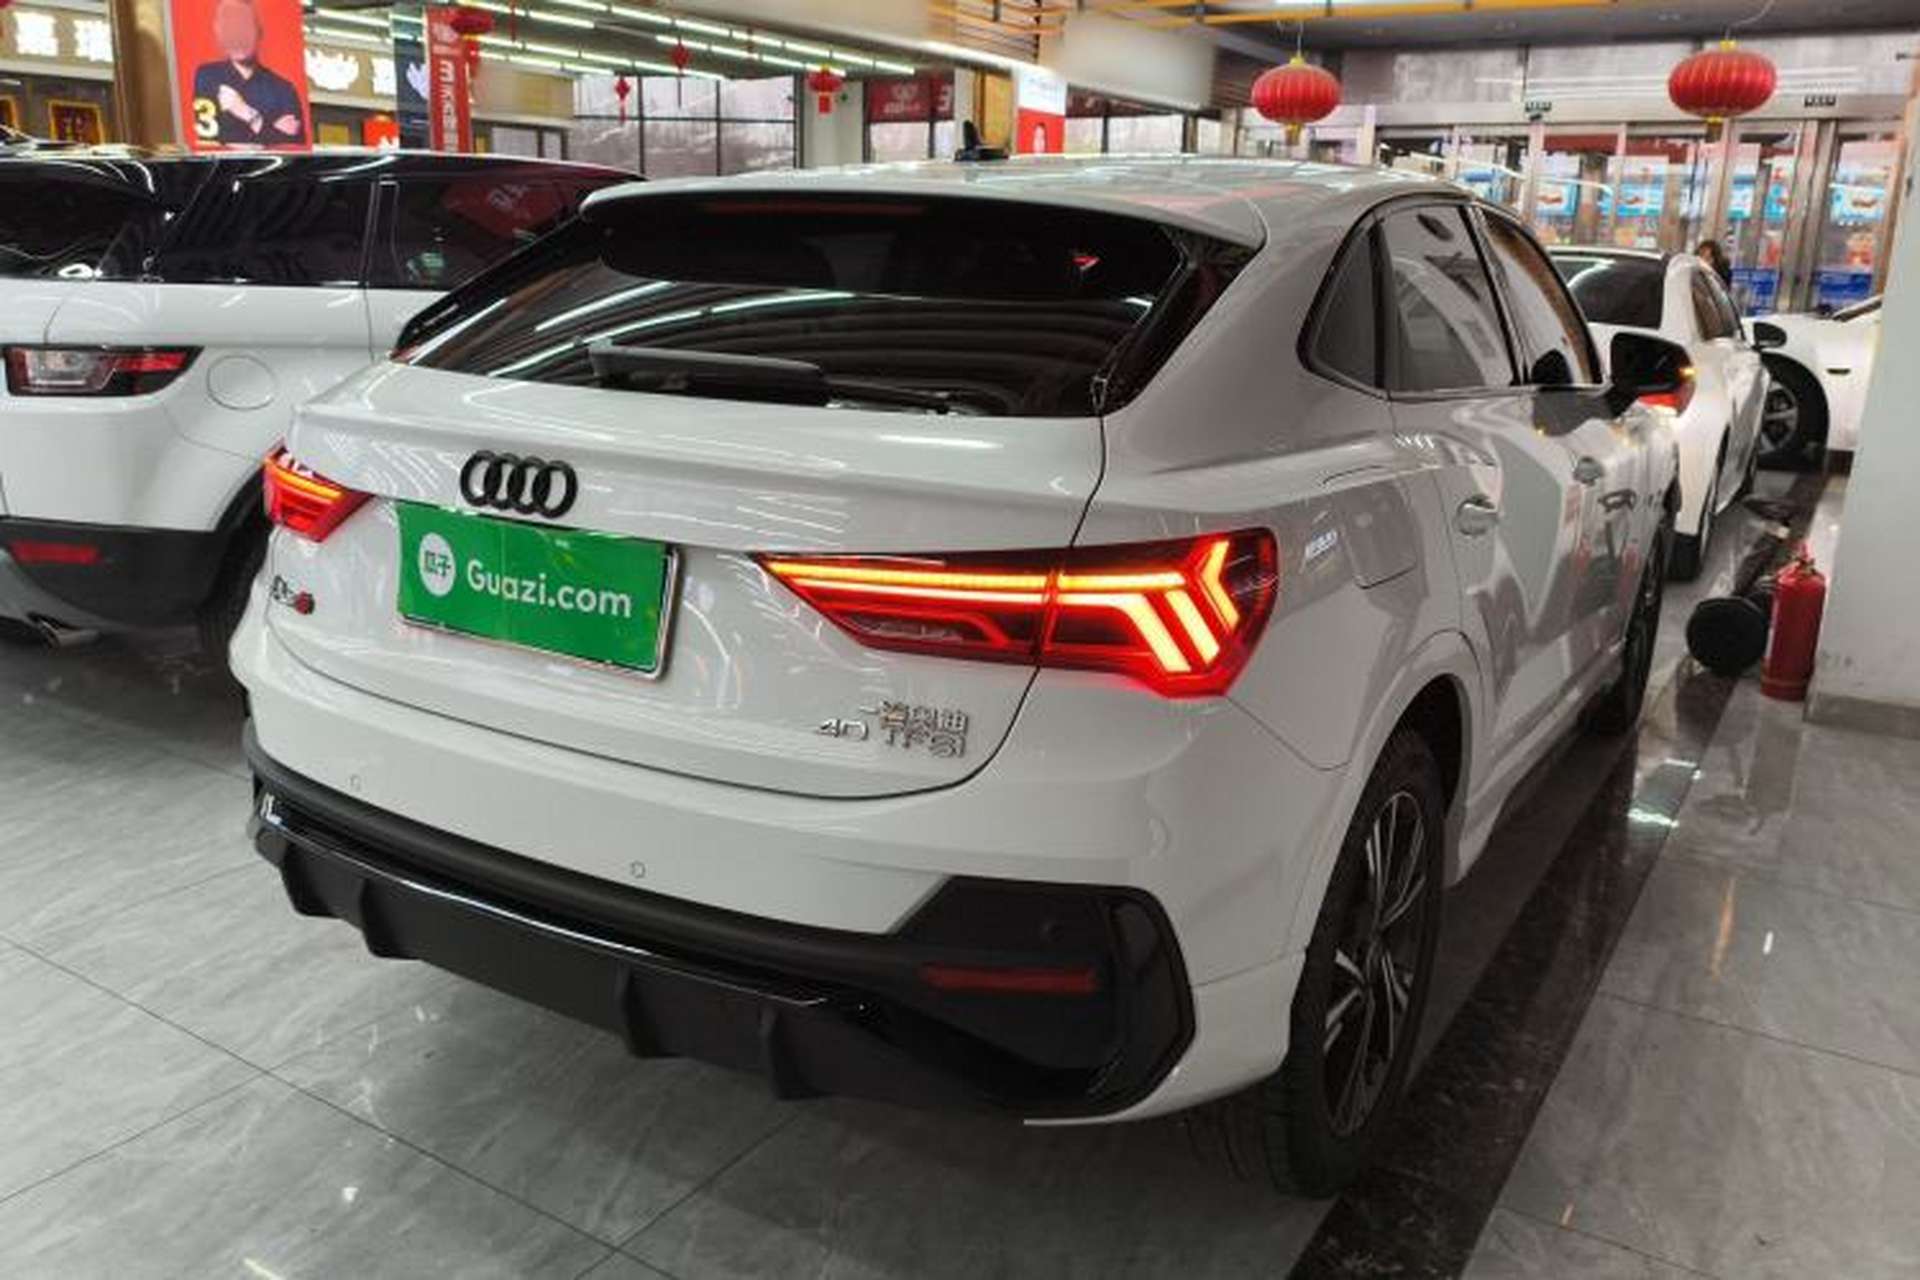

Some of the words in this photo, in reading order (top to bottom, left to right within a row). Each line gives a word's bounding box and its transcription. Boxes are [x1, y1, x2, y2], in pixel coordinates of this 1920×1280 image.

[467, 559, 632, 618] Guazi.com
[816, 718, 869, 741] 40
[884, 727, 967, 758] TFSI
